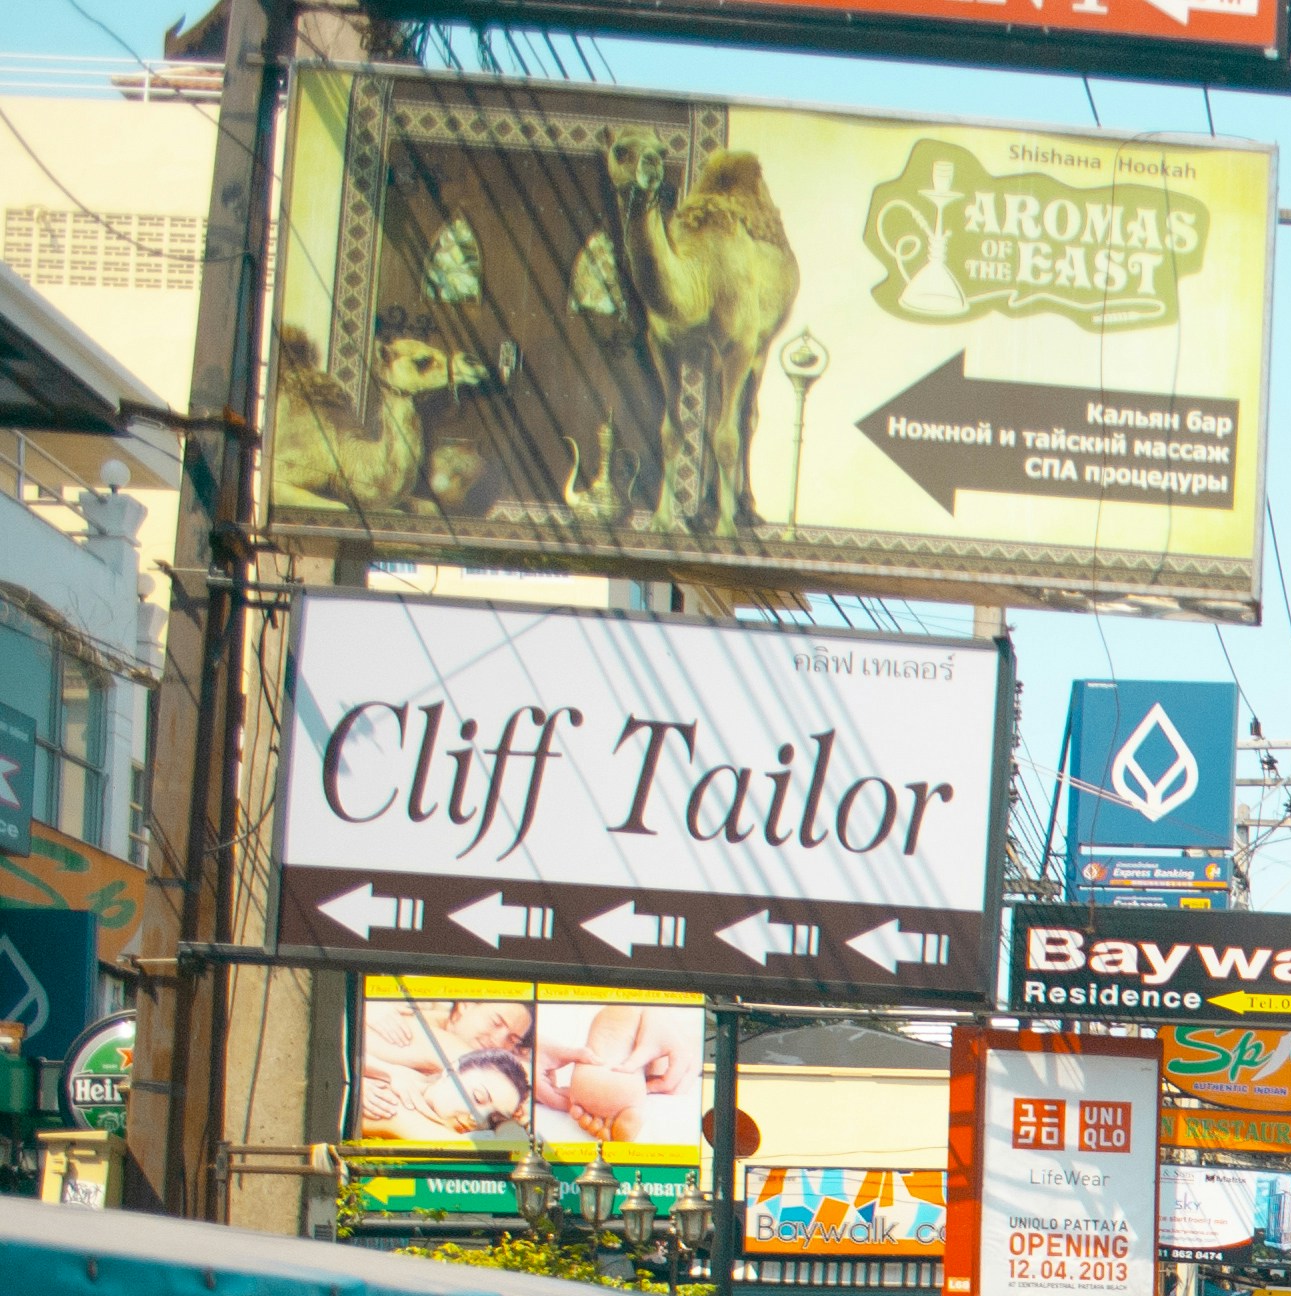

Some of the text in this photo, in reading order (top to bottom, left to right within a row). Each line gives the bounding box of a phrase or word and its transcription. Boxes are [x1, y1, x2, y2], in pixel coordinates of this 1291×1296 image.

[1119, 156, 1197, 180] Hookah
[965, 191, 1198, 254] AROMAS
[980, 239, 1013, 258] OF
[965, 259, 1011, 282] THE
[1016, 241, 1163, 295] EAST
[1087, 402, 1233, 438] Кальян бар
[888, 416, 1230, 464] Ножной и тайский массаж
[1024, 457, 1229, 494] СПА процедуры
[321, 699, 954, 862] Cliff Tailor
[1113, 867, 1195, 879] Express Banking
[1024, 981, 1202, 1009] Residence
[1193, 1082, 1247, 1093] AUTHENTIC
[1254, 1086, 1287, 1096] INDIAN
[1085, 1107, 1122, 1126] UNI
[1084, 1127, 1125, 1149] QLO
[426, 1176, 507, 1195] Welcome
[1030, 1168, 1110, 1187] LifeWear
[756, 1214, 899, 1249] Baywalk
[1009, 1217, 1129, 1232] UNIQLO PATTAYA
[1009, 1232, 1129, 1259] OPENING
